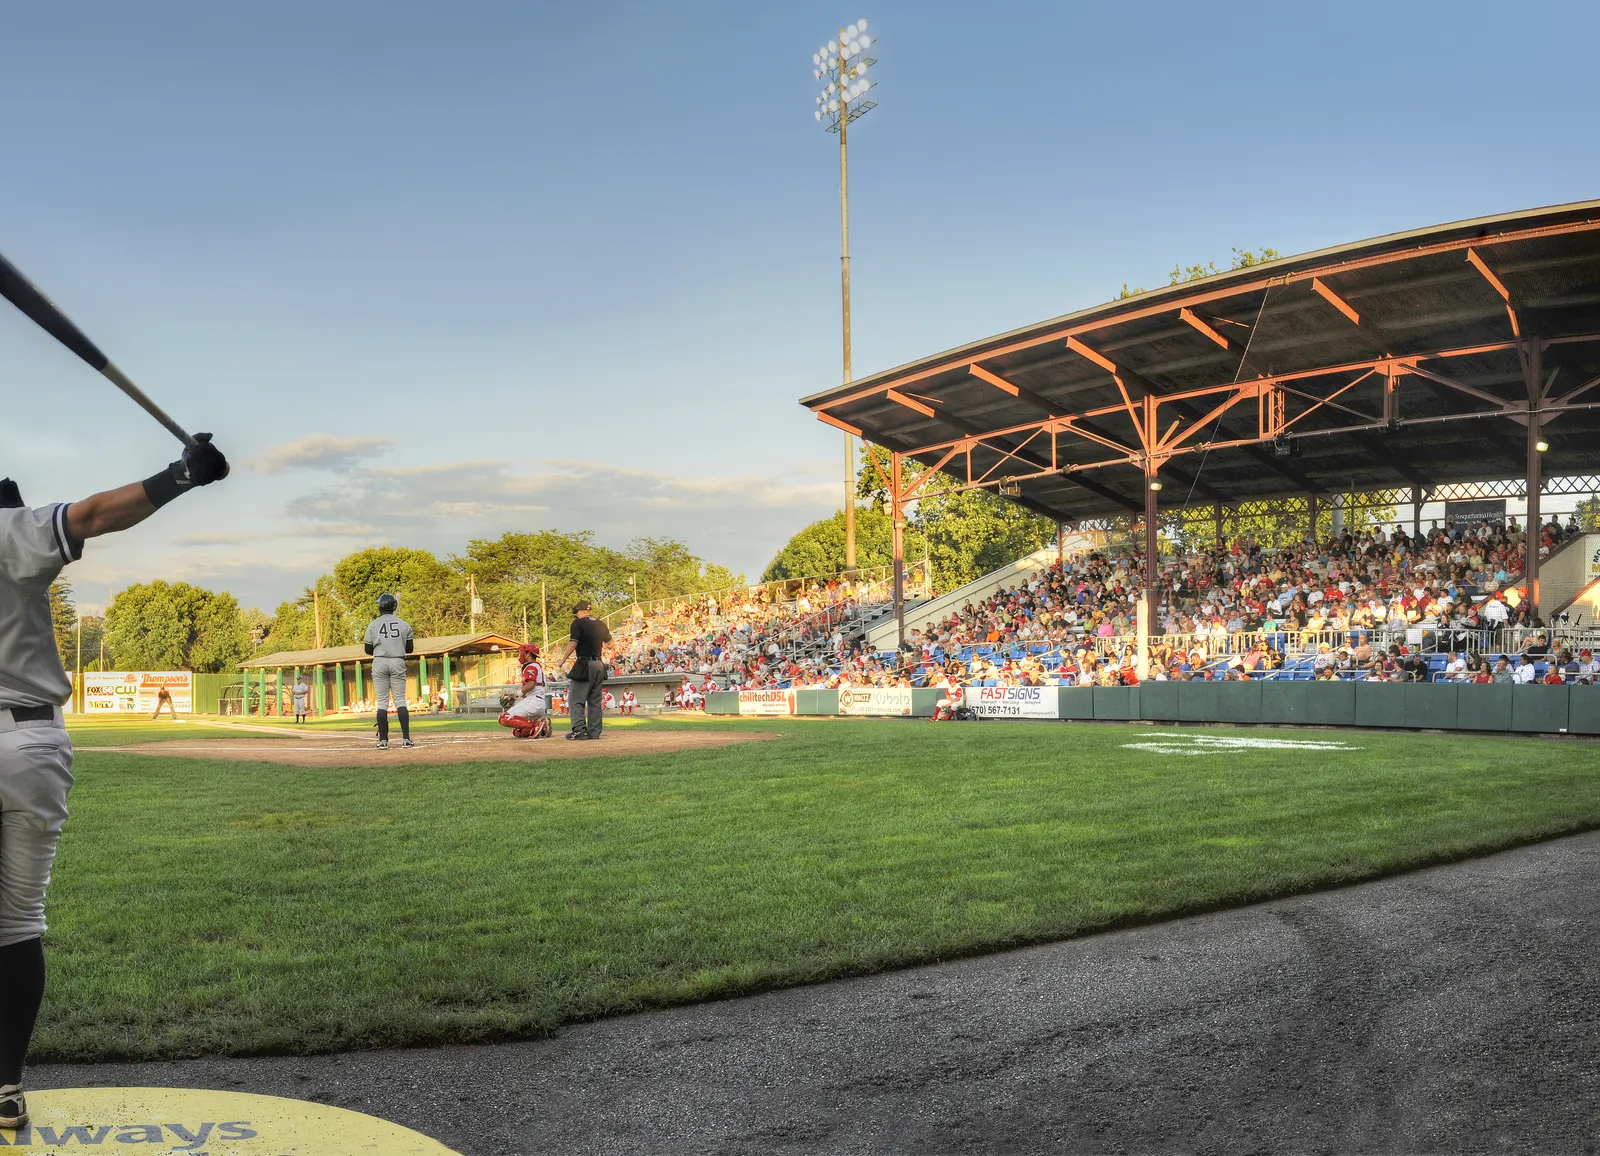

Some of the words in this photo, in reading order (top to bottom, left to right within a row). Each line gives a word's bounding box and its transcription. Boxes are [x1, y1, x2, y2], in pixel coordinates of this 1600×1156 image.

[378, 621, 401, 640] 45
[142, 674, 188, 683] Thompson's
[87, 686, 101, 694] FOX
[115, 686, 137, 695] CW
[980, 688, 1041, 700] FASTSIGNS
[988, 706, 1021, 715] 567-7131
